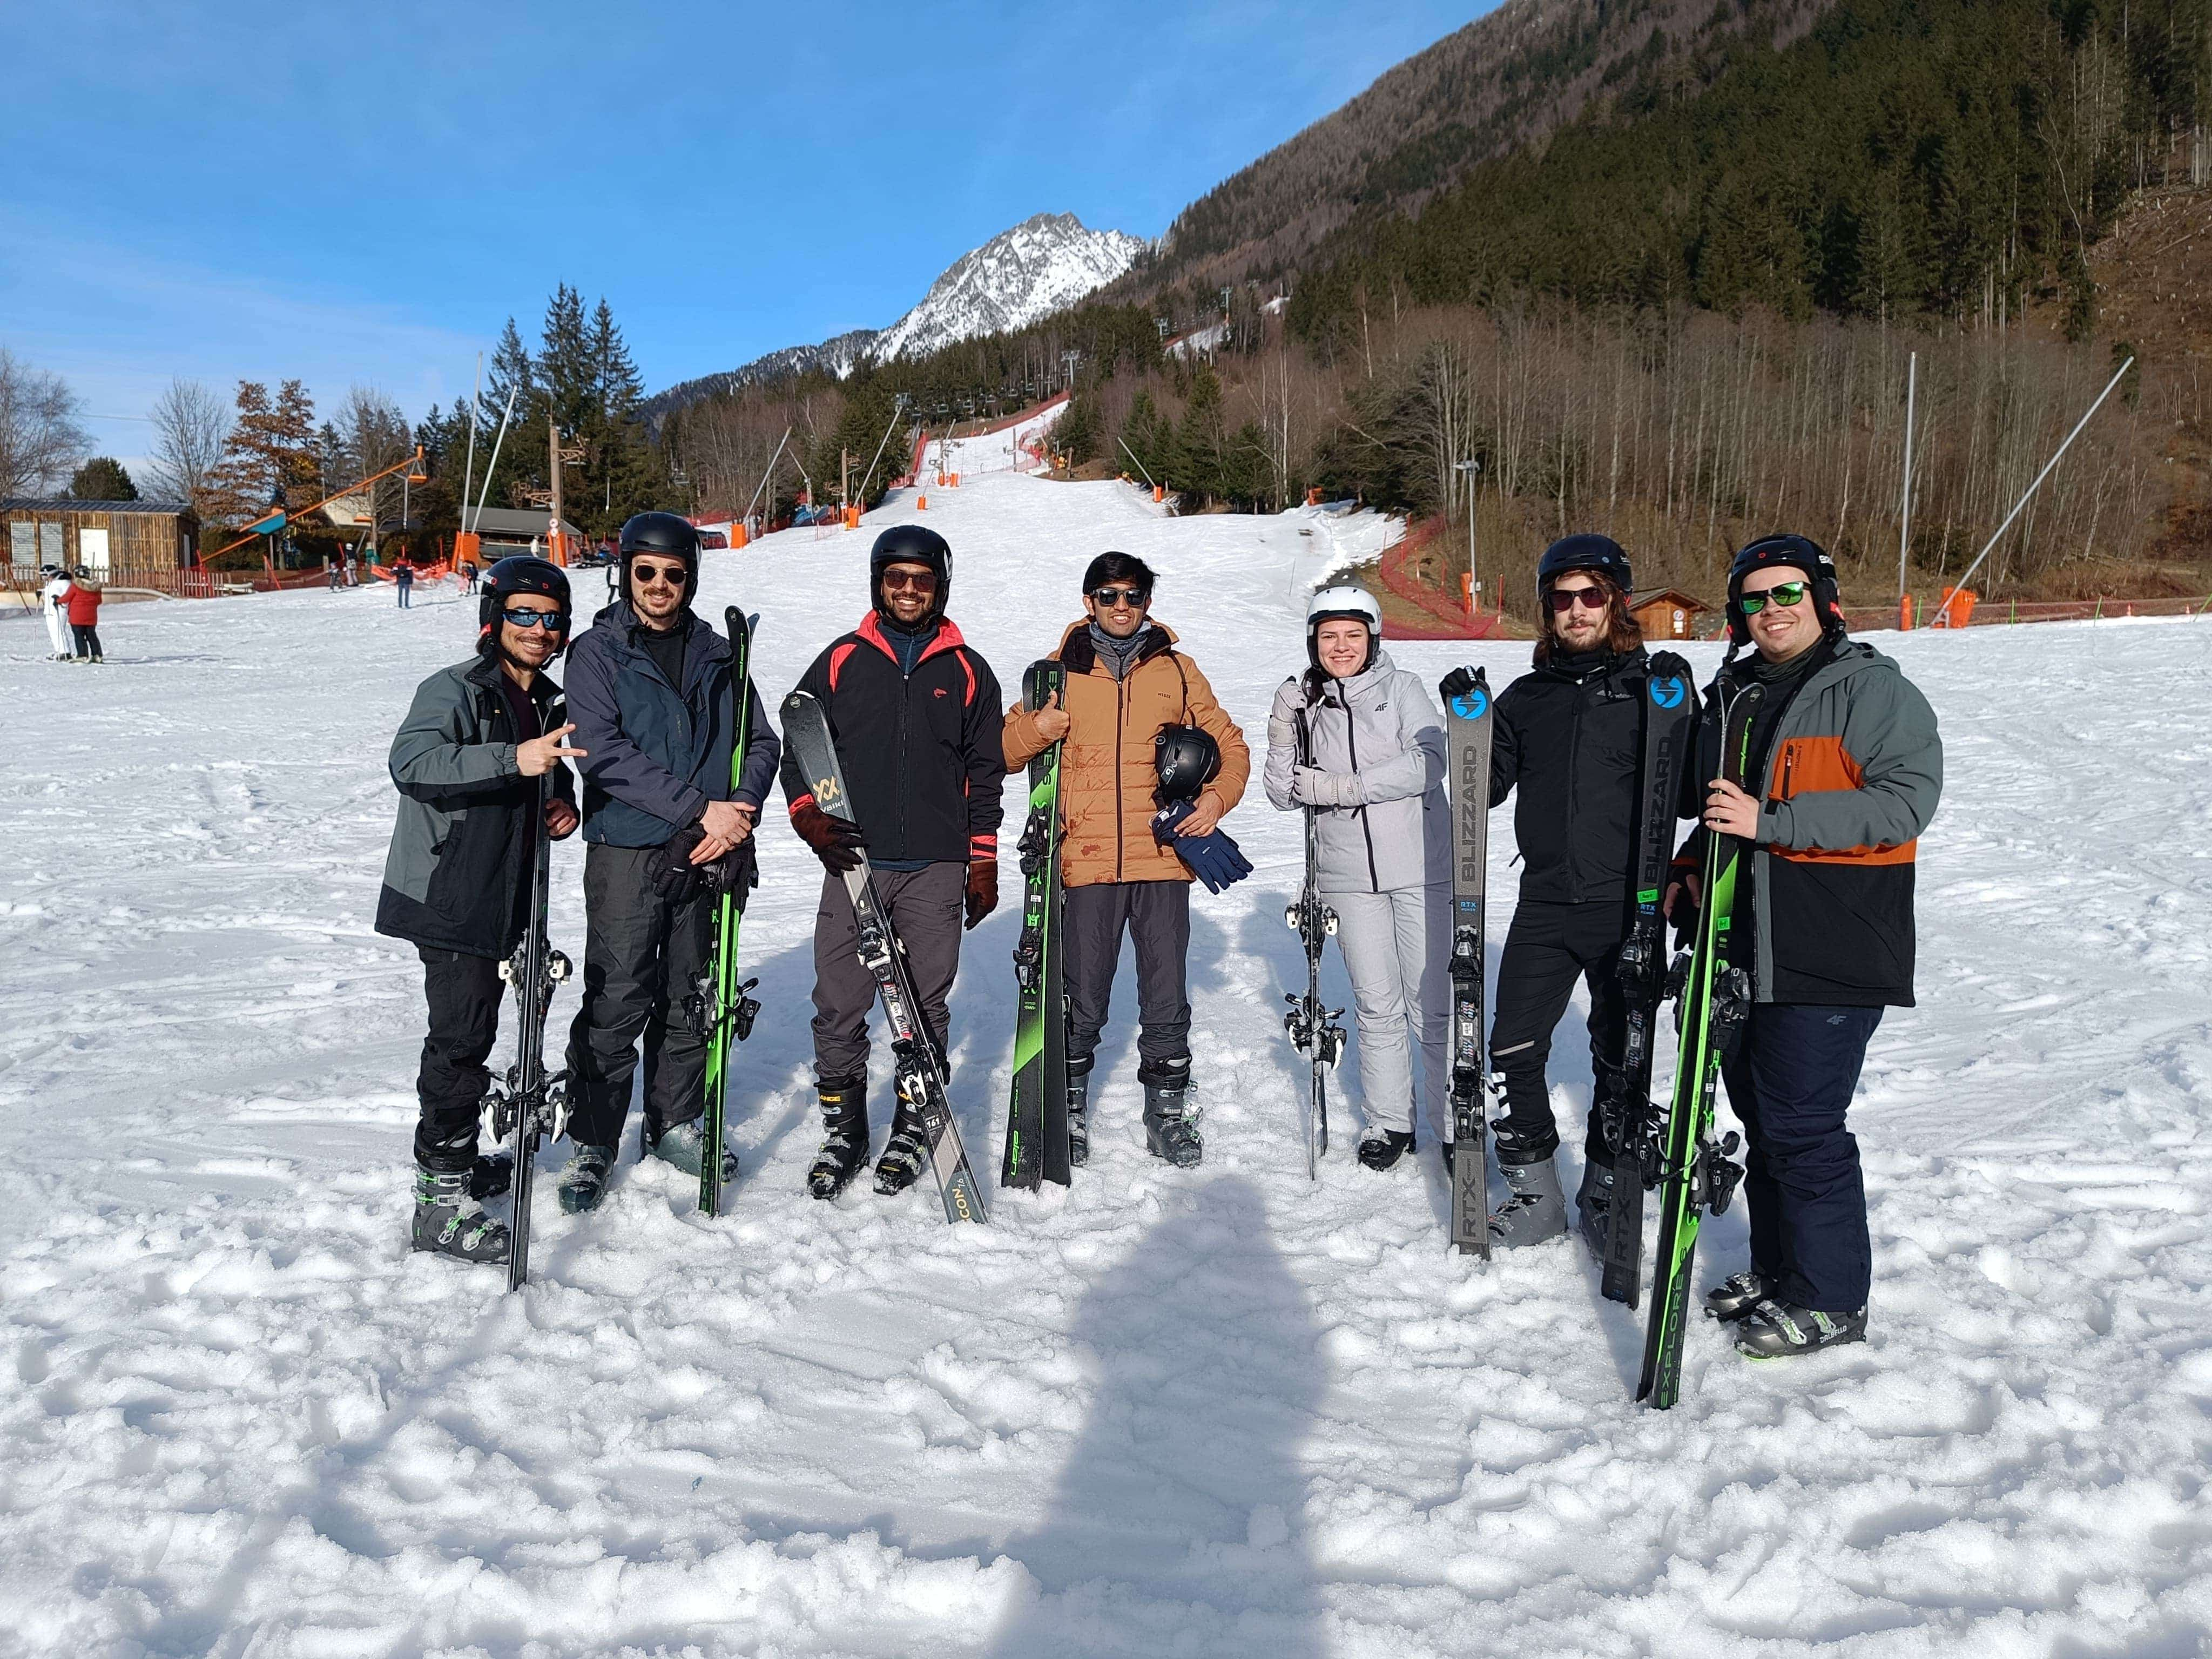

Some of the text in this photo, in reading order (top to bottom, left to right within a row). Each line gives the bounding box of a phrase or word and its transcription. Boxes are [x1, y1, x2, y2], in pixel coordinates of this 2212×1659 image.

[1374, 702, 1388, 711] 4F
[1461, 745, 1477, 882] BLIZZARD
[1644, 736, 1672, 884] BLIZZARD
[1826, 1015, 1847, 1025] 4F
[926, 1117, 940, 1129] 161
[1010, 1130, 1020, 1176] elan
[952, 1188, 970, 1222] CON
[1462, 1177, 1476, 1237] RTX
[1614, 1196, 1631, 1262] RTX
[1660, 1273, 1684, 1408] EXPLORE
[1819, 1325, 1847, 1344] DALBELLO
